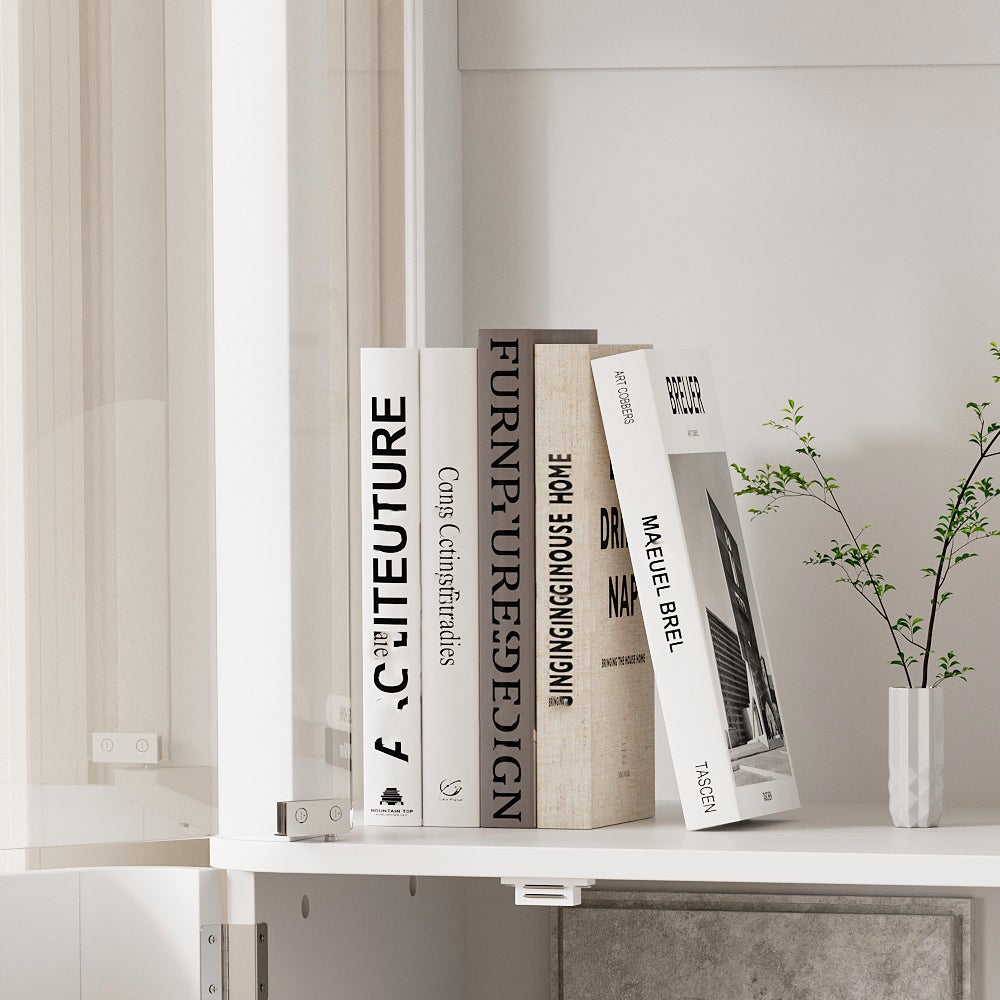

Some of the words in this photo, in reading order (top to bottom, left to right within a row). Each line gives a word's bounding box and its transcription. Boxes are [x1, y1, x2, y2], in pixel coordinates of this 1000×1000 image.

[614, 371, 627, 386] ART
[665, 376, 706, 415] BREUER
[617, 387, 635, 425] COBBERS
[548, 454, 574, 504] HOME
[659, 600, 684, 653] BREL
[695, 761, 717, 814] TASCEN
